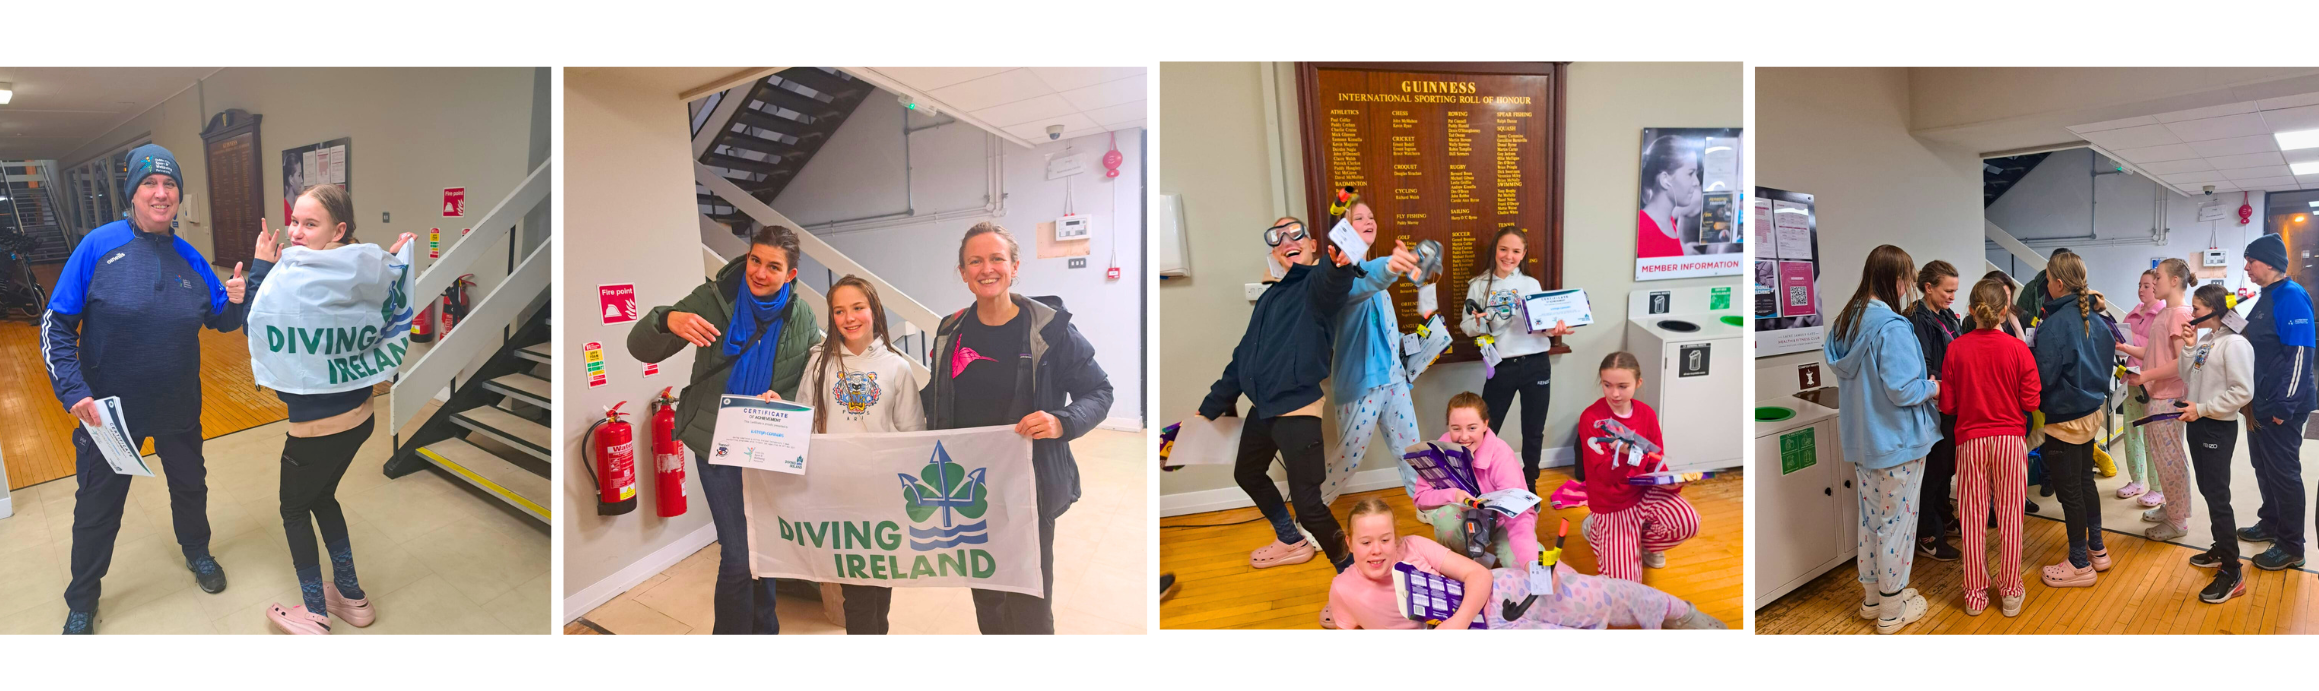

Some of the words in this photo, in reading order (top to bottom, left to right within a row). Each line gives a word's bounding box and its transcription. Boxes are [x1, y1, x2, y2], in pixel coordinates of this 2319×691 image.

[1402, 80, 1476, 94] GUINNESS
[1339, 93, 1411, 102] INTERNATIONAL
[1414, 95, 1456, 103] SPORTING
[1459, 96, 1480, 104] ROLL
[1483, 96, 1493, 104] OF
[1642, 264, 1678, 272] MEMBER
[1681, 261, 1739, 270] INFORMATION
[616, 288, 632, 296] point
[267, 325, 377, 355] DIVING
[327, 337, 409, 384] IRELAN
[744, 408, 788, 418] CERTIFICATE
[778, 516, 902, 551] DIVING
[834, 549, 996, 580] IRELAND
